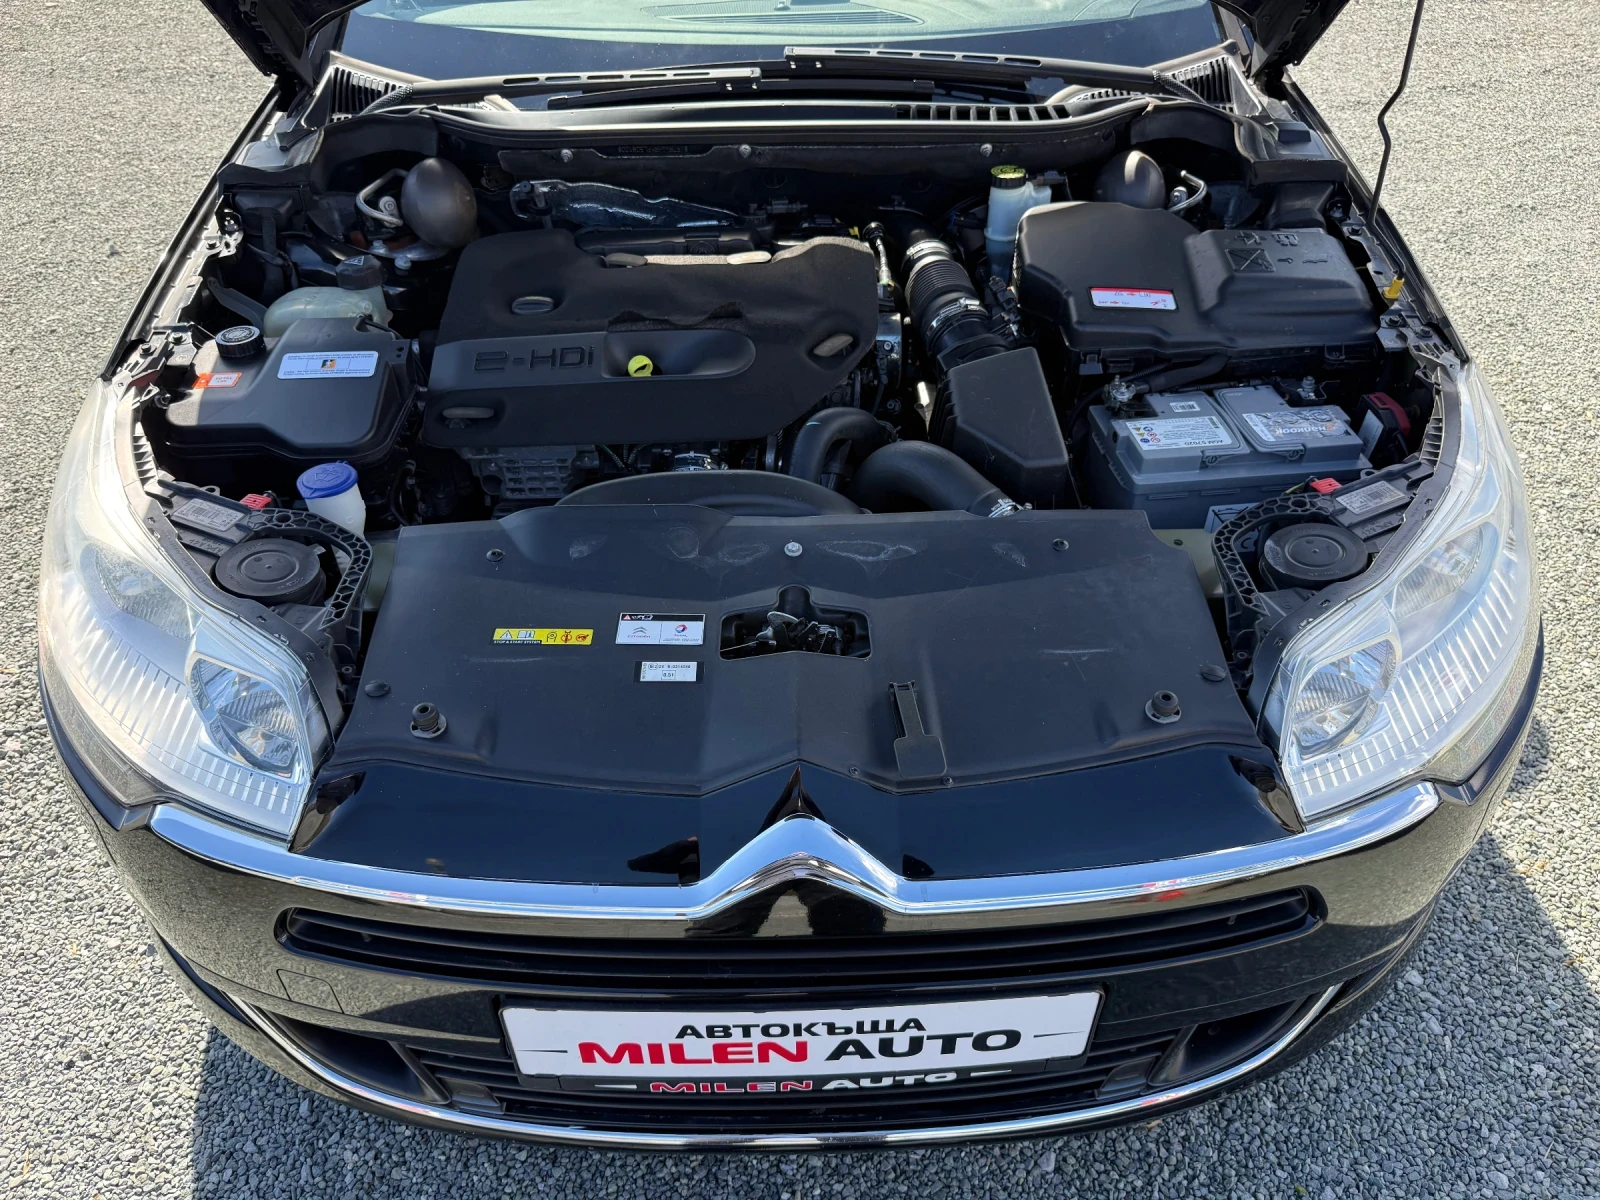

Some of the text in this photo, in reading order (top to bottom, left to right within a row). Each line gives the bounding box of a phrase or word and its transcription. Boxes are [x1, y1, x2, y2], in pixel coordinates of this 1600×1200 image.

[675, 1017, 927, 1039] АВТОКЪША
[578, 1029, 1022, 1064] MILEN AUTO
[649, 1070, 957, 1093] MILEN AUTO
